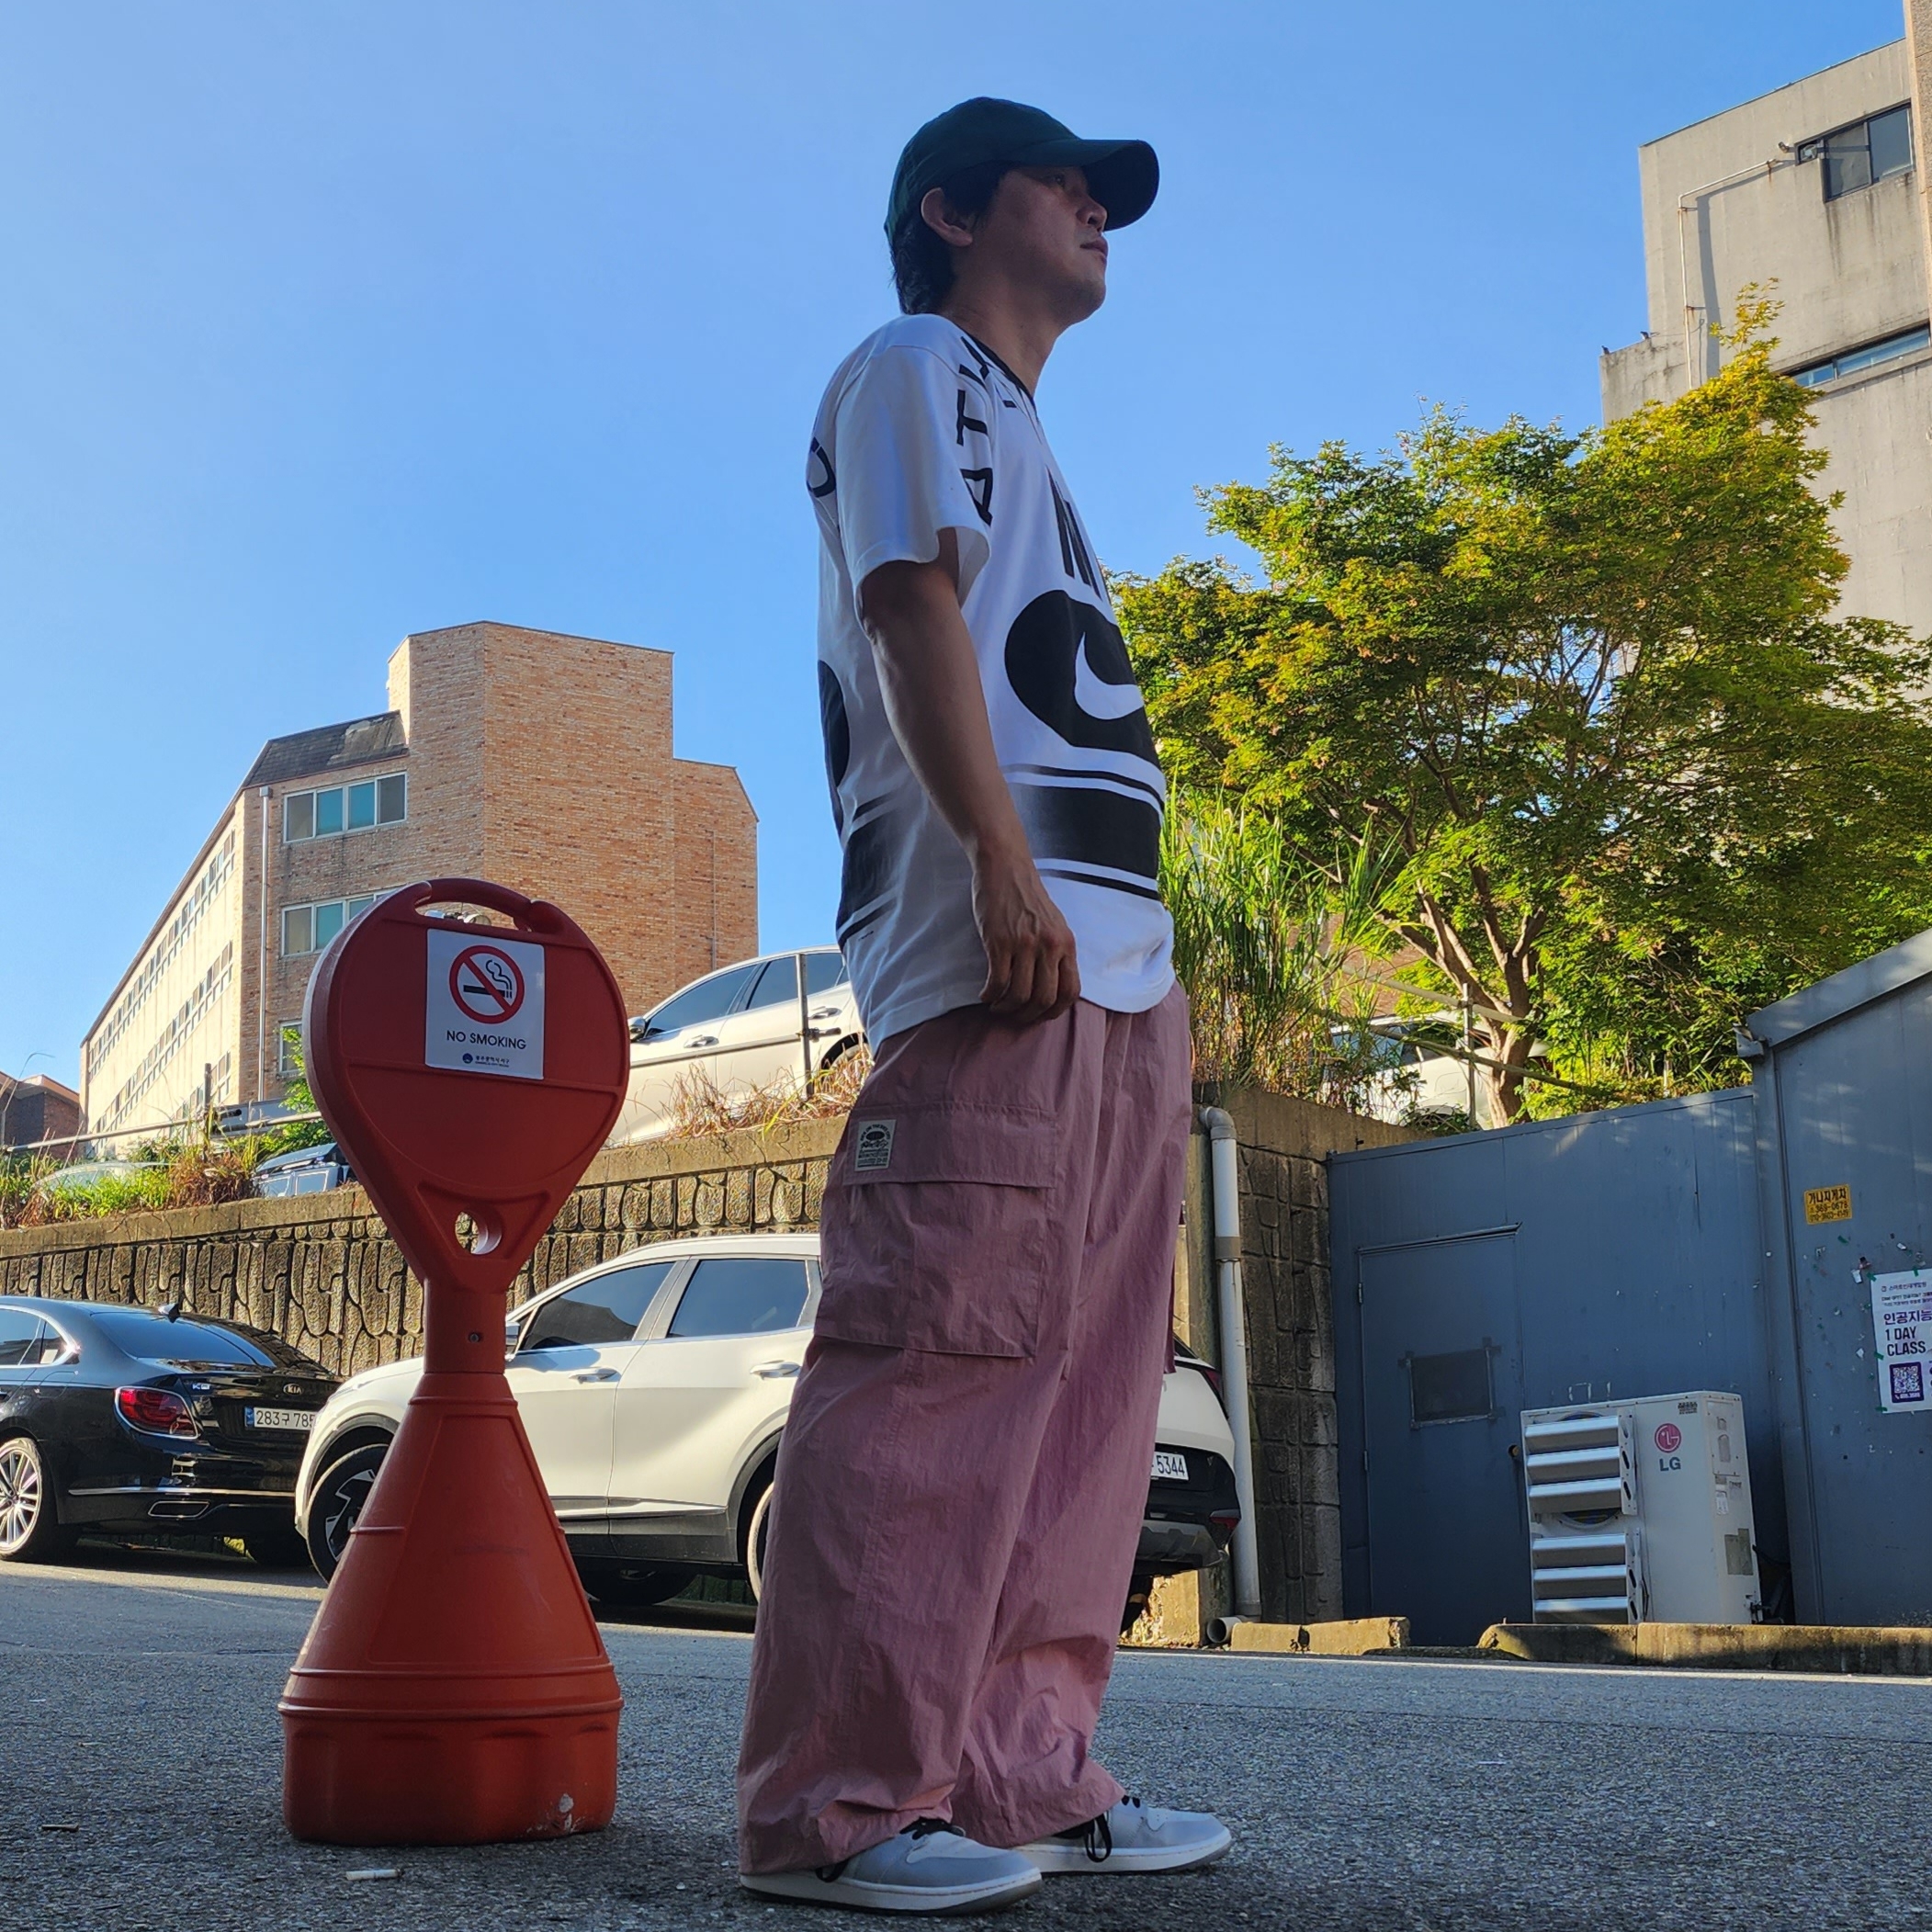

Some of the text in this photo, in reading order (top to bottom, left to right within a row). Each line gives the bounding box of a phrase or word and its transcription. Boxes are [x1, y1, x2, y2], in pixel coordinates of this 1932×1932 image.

[446, 1030, 527, 1050] NO SMOKING
[1883, 1309, 1932, 1326] 인공지능
[1885, 1326, 1917, 1341] 1 DAY
[1886, 1340, 1927, 1357] CLASS
[288, 1385, 302, 1395] KIA
[255, 1409, 316, 1429] 283구 785
[1156, 1455, 1186, 1476] 5344
[1658, 1456, 1682, 1472] LG
